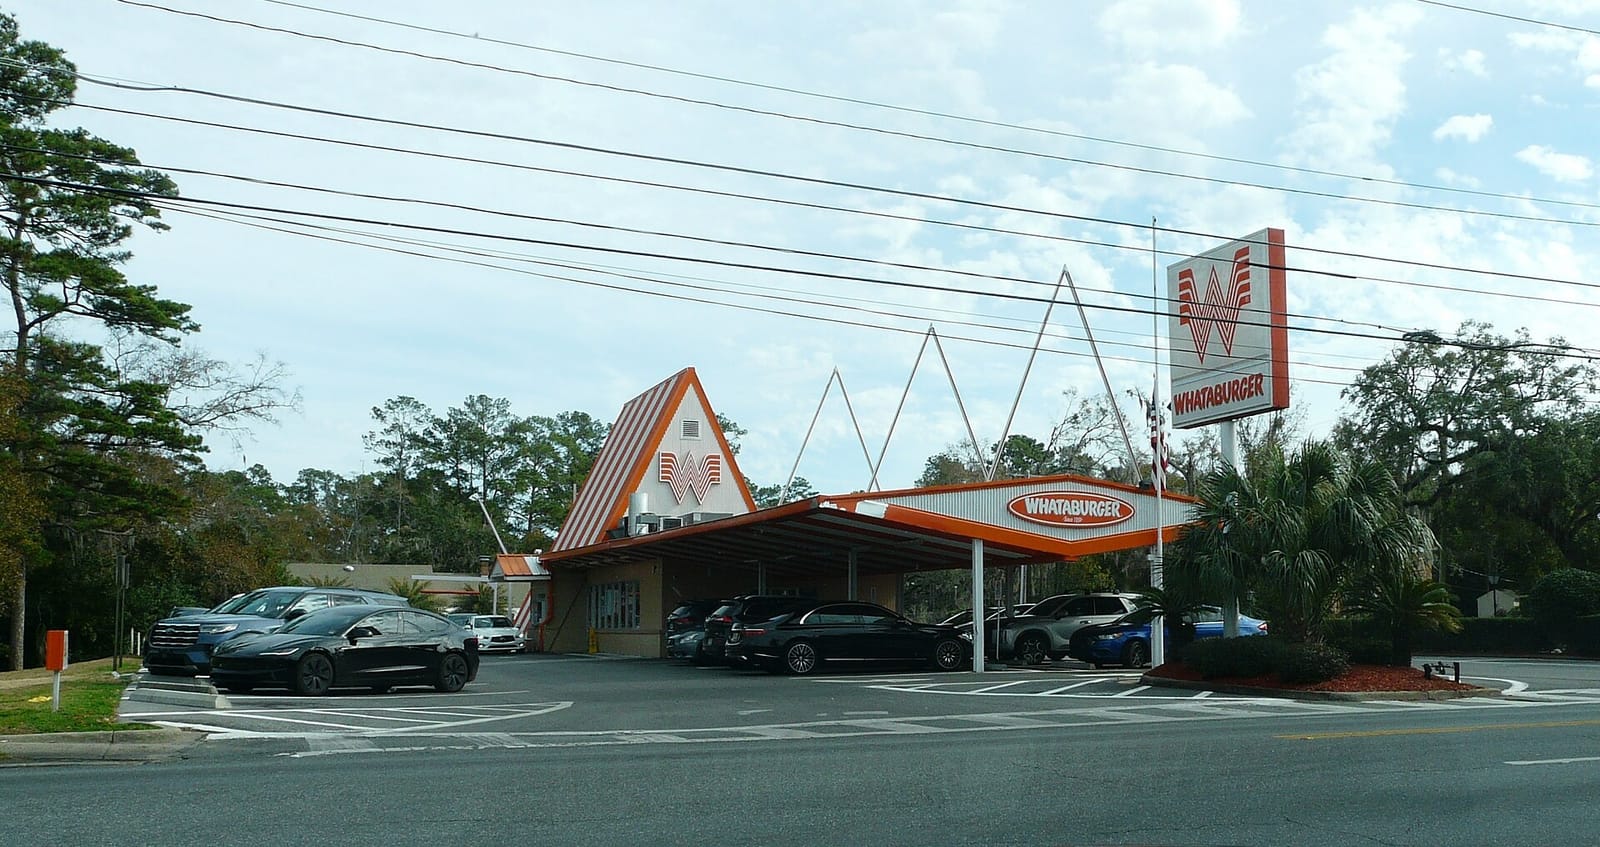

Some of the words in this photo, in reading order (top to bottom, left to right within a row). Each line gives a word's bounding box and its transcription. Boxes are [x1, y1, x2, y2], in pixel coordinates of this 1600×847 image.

[1179, 246, 1251, 364] W
[1173, 373, 1265, 415] WHATABURGER
[659, 450, 721, 505] W
[1025, 497, 1121, 517] WHATABURGER
